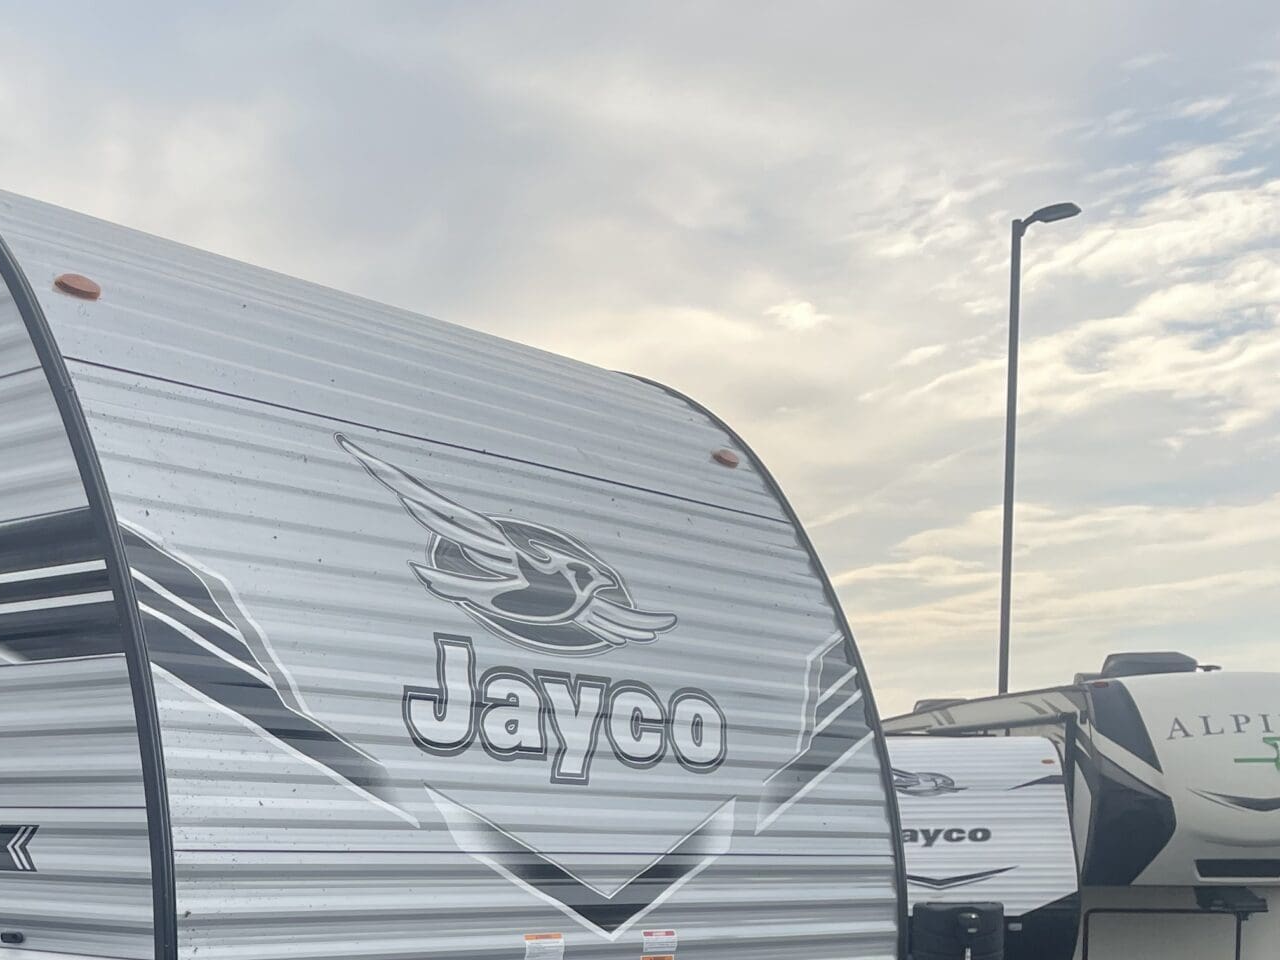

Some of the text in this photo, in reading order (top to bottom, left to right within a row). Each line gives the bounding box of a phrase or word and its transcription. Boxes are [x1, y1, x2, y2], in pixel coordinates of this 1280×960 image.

[402, 632, 727, 786] Jayco
[1166, 713, 1280, 740] ALPI
[902, 827, 991, 848] ayco
